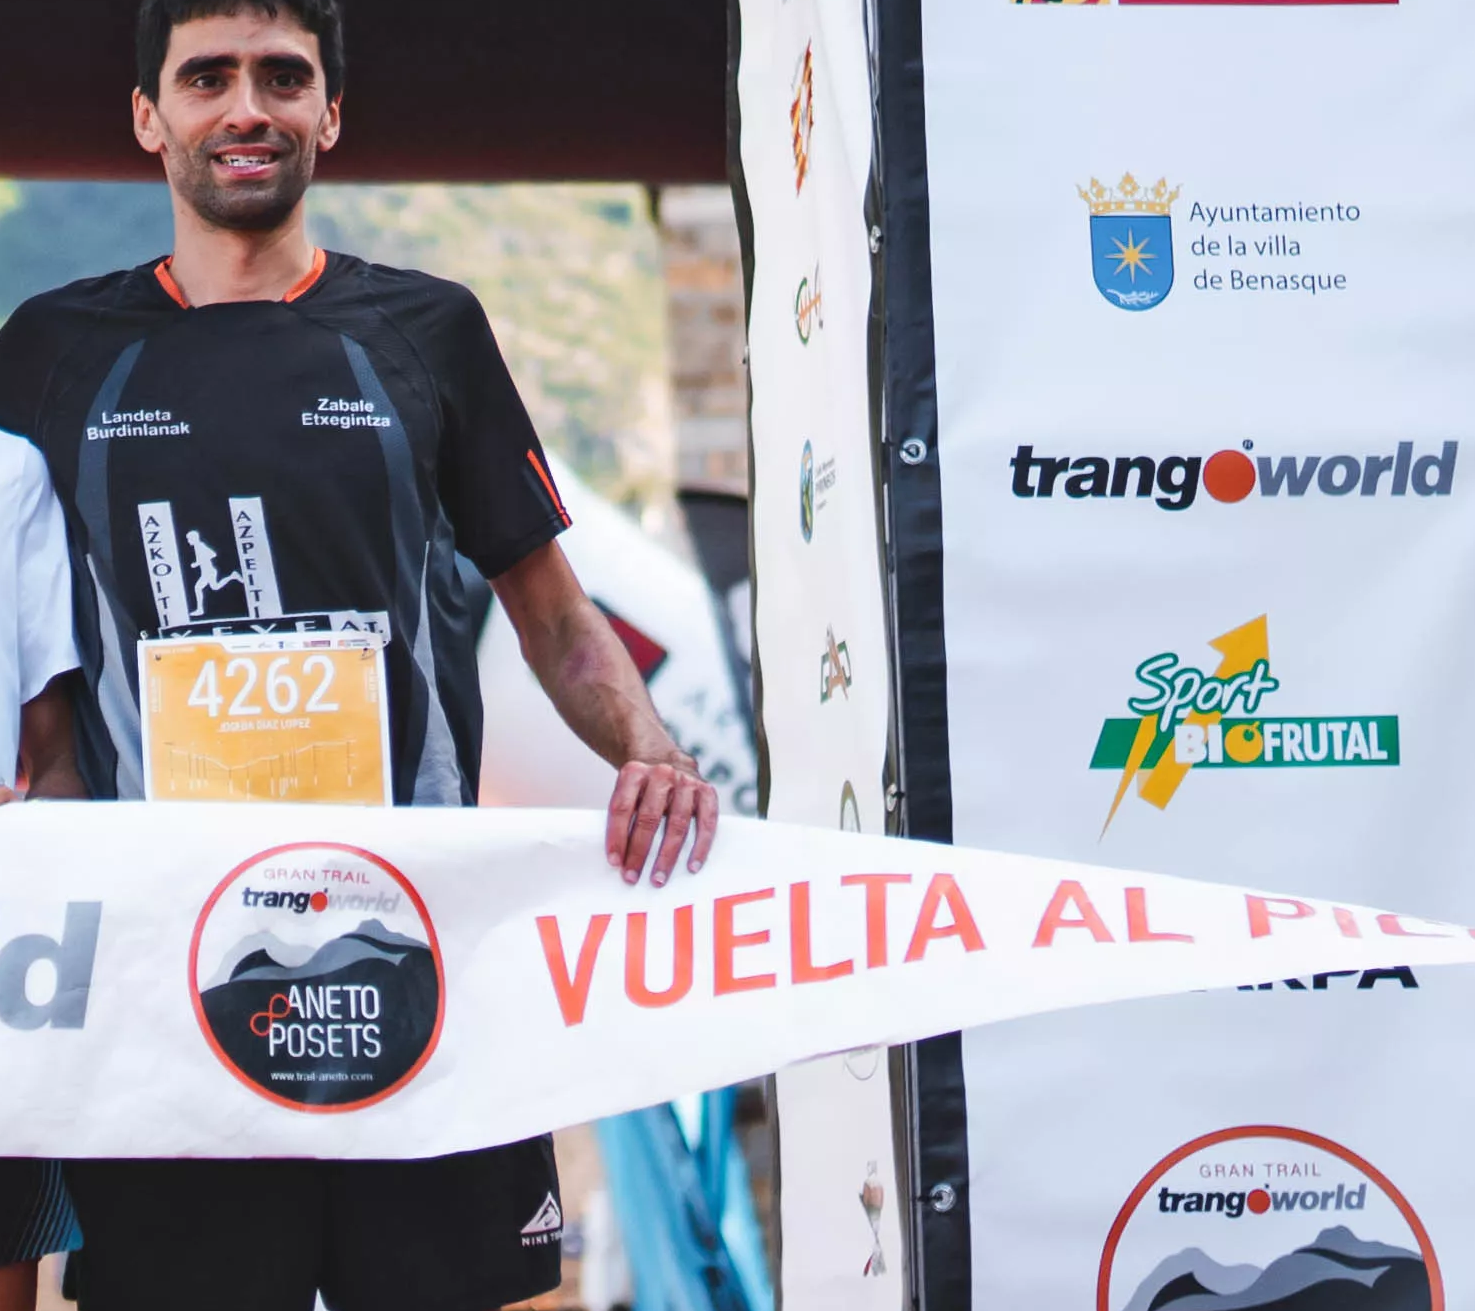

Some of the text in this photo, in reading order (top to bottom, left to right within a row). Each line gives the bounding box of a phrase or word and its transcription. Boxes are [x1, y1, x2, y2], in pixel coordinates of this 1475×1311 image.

[1189, 199, 1361, 226] Ayuntamiento
[1191, 234, 1301, 256] de la villa
[1193, 269, 1347, 295] de Benasque
[102, 409, 172, 425] Landeta
[317, 398, 375, 413] Zabale
[301, 412, 391, 429] Etxegintza
[188, 654, 340, 718] 4262
[1130, 652, 1279, 731] Sport
[263, 867, 371, 885] GRAN TRAIL
[534, 872, 986, 1028] VUELTA
[1031, 879, 1195, 950] AL
[288, 984, 381, 1020] ANETO
[268, 1022, 382, 1058] POSETS
[1199, 1162, 1323, 1179] GRAN TRAIL
